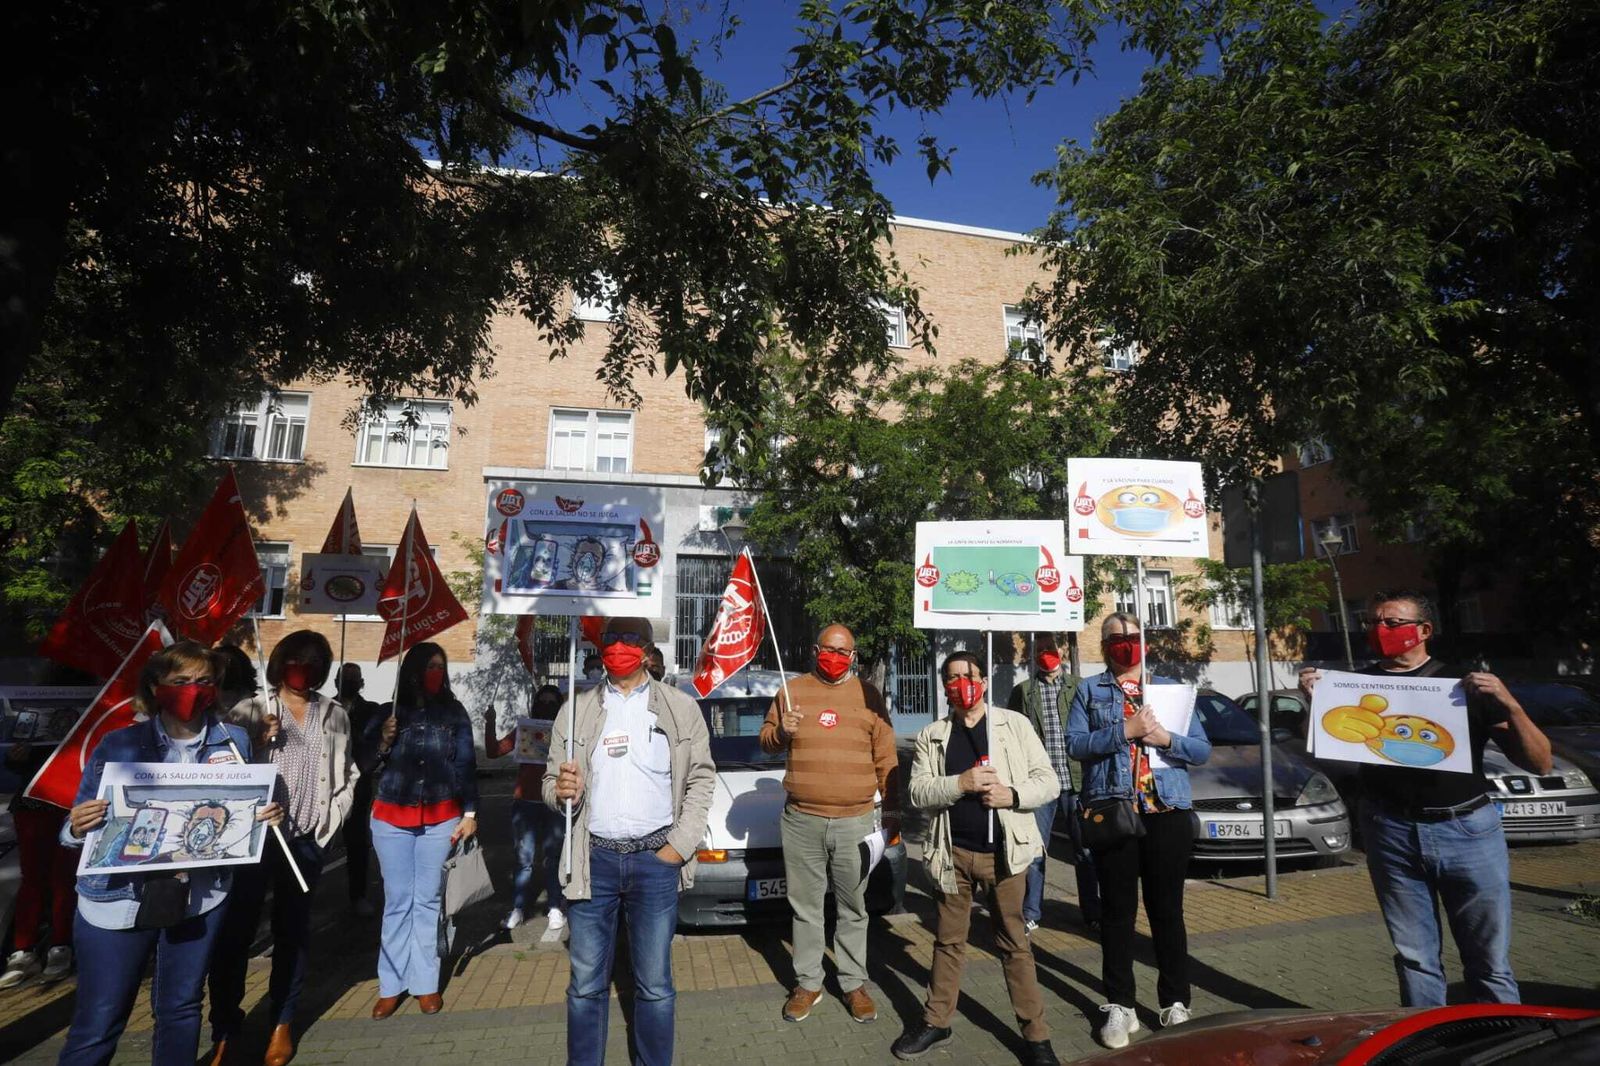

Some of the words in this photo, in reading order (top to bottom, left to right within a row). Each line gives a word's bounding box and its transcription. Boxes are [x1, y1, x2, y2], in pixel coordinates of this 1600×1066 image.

[502, 493, 522, 505] UGT
[598, 511, 619, 519] JUEGA
[636, 543, 657, 556] UGT
[920, 566, 936, 577] UGT
[1039, 566, 1057, 579] UGT
[1067, 588, 1081, 596] UGT
[134, 772, 154, 780] CON
[156, 772, 168, 780] LA
[170, 772, 198, 780] SALUD
[200, 772, 213, 780] NO
[215, 772, 224, 780] SE
[225, 772, 252, 780] JUEGA
[1504, 803, 1535, 815] 4413
[1540, 802, 1565, 815] BYM
[1217, 824, 1250, 837] 8784
[1260, 824, 1284, 836] DJ
